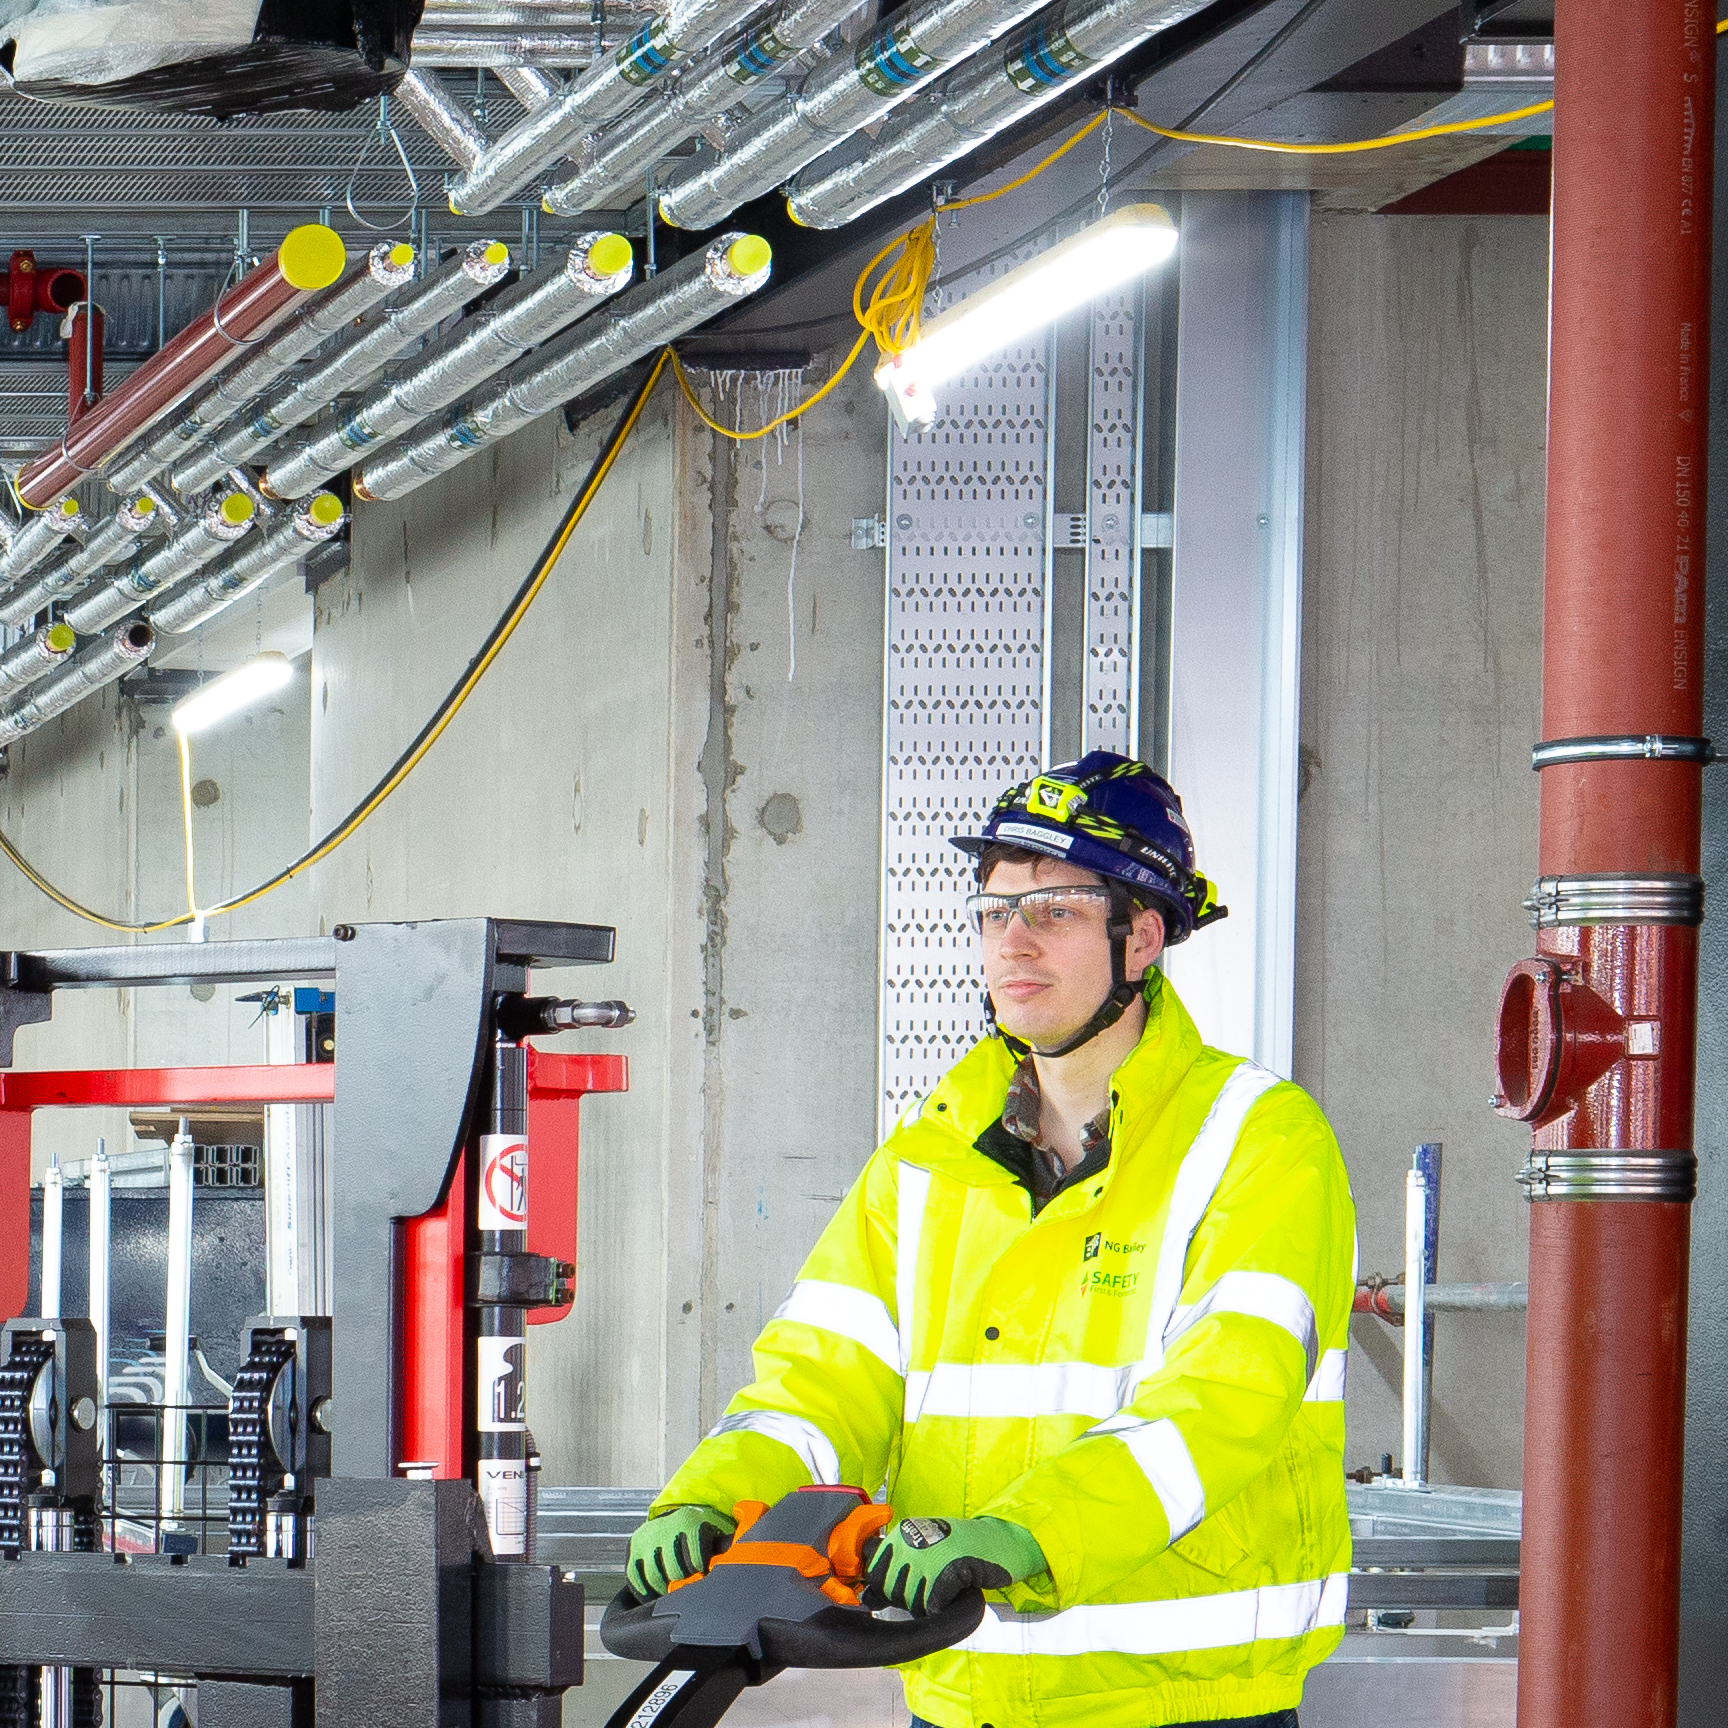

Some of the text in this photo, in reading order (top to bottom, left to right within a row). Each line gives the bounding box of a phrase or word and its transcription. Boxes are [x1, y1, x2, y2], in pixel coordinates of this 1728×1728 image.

[1679, 322, 1692, 350] Made
[1679, 366, 1691, 402] France
[1676, 456, 1690, 476] DN
[1676, 481, 1690, 507] 150
[1672, 630, 1688, 690] ENSIGN
[1104, 1241, 1120, 1252] NG
[1092, 1271, 1140, 1288] SAFETY
